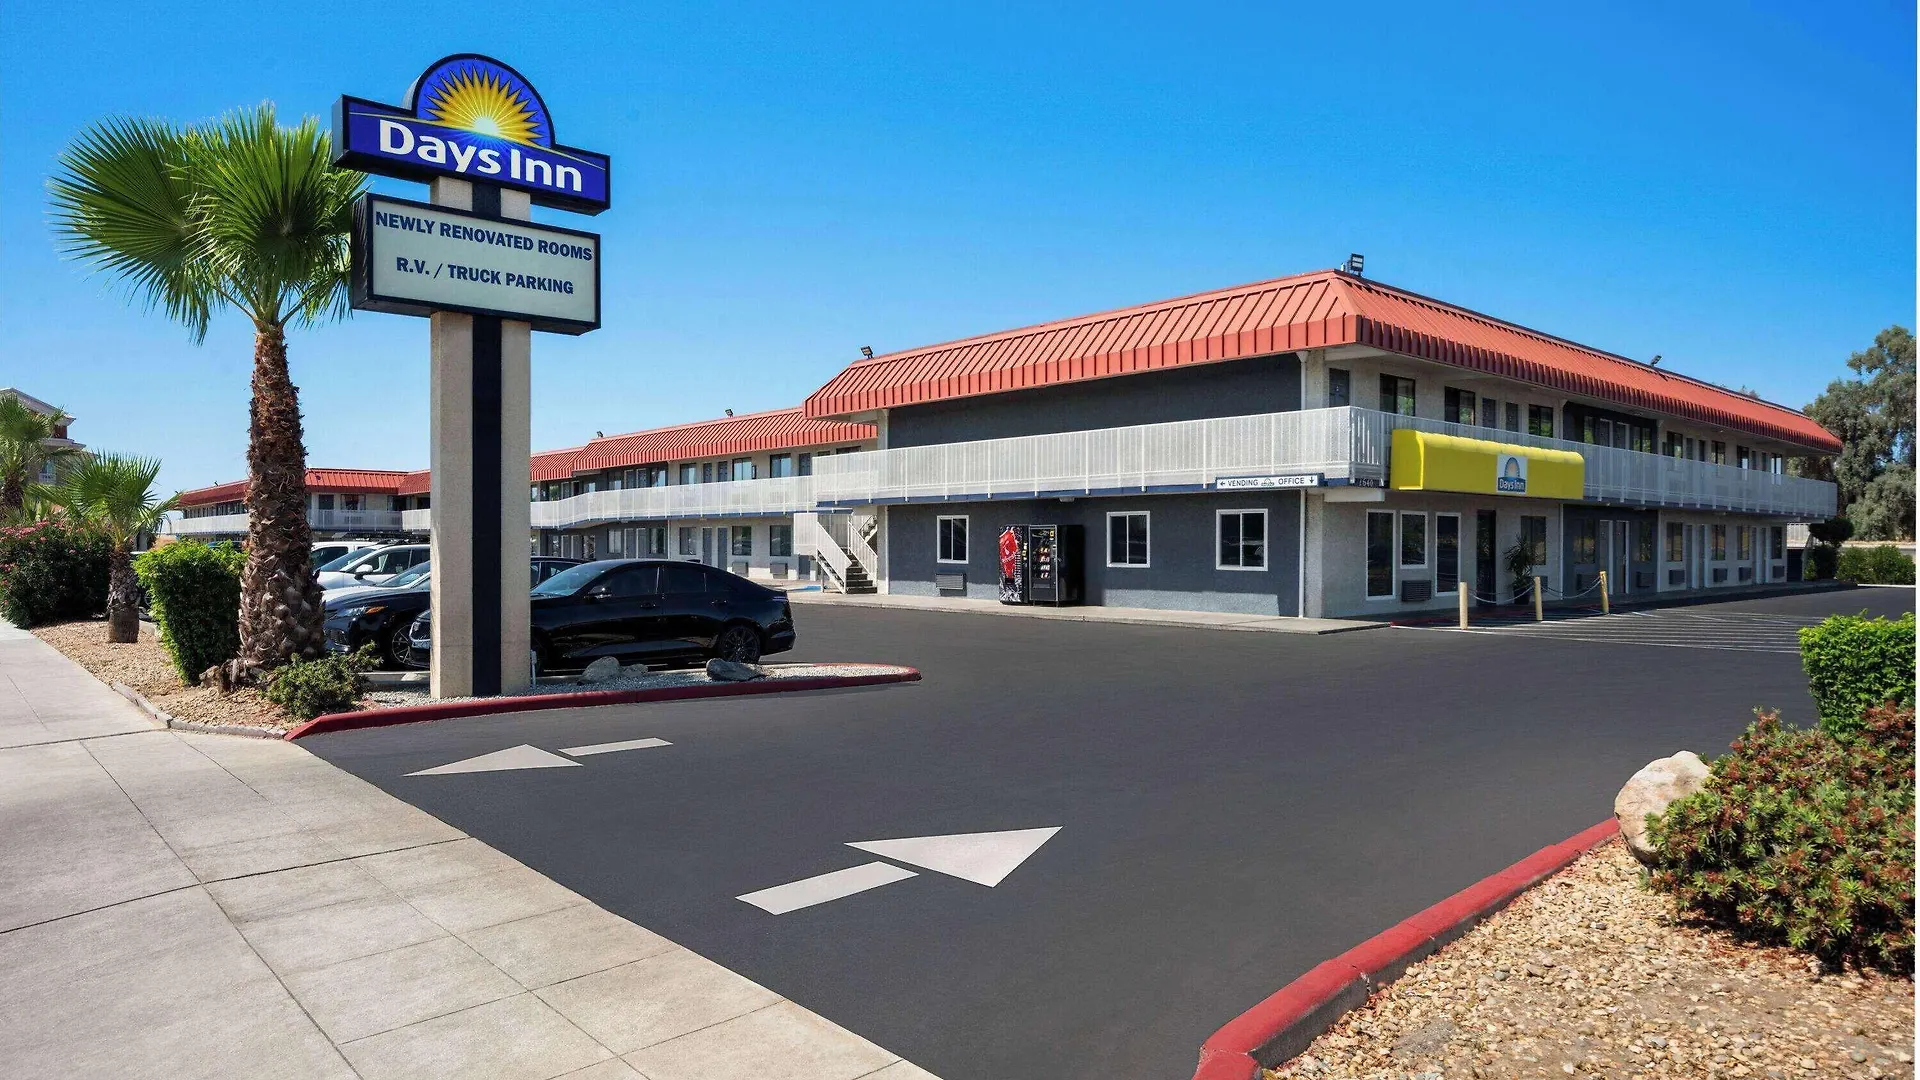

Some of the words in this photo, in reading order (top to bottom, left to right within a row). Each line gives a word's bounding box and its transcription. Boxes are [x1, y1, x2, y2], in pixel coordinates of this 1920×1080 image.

[380, 119, 501, 173] Days
[511, 148, 582, 192] Inn
[375, 211, 435, 234] NEWLY
[440, 222, 534, 251] RENOVATED
[538, 240, 593, 261] ROOMS
[396, 257, 430, 275] R.V.
[447, 264, 501, 285] TRUCK
[505, 272, 574, 294] PARKING
[1227, 479, 1259, 487] VENDING
[1278, 477, 1305, 485] OFFICE
